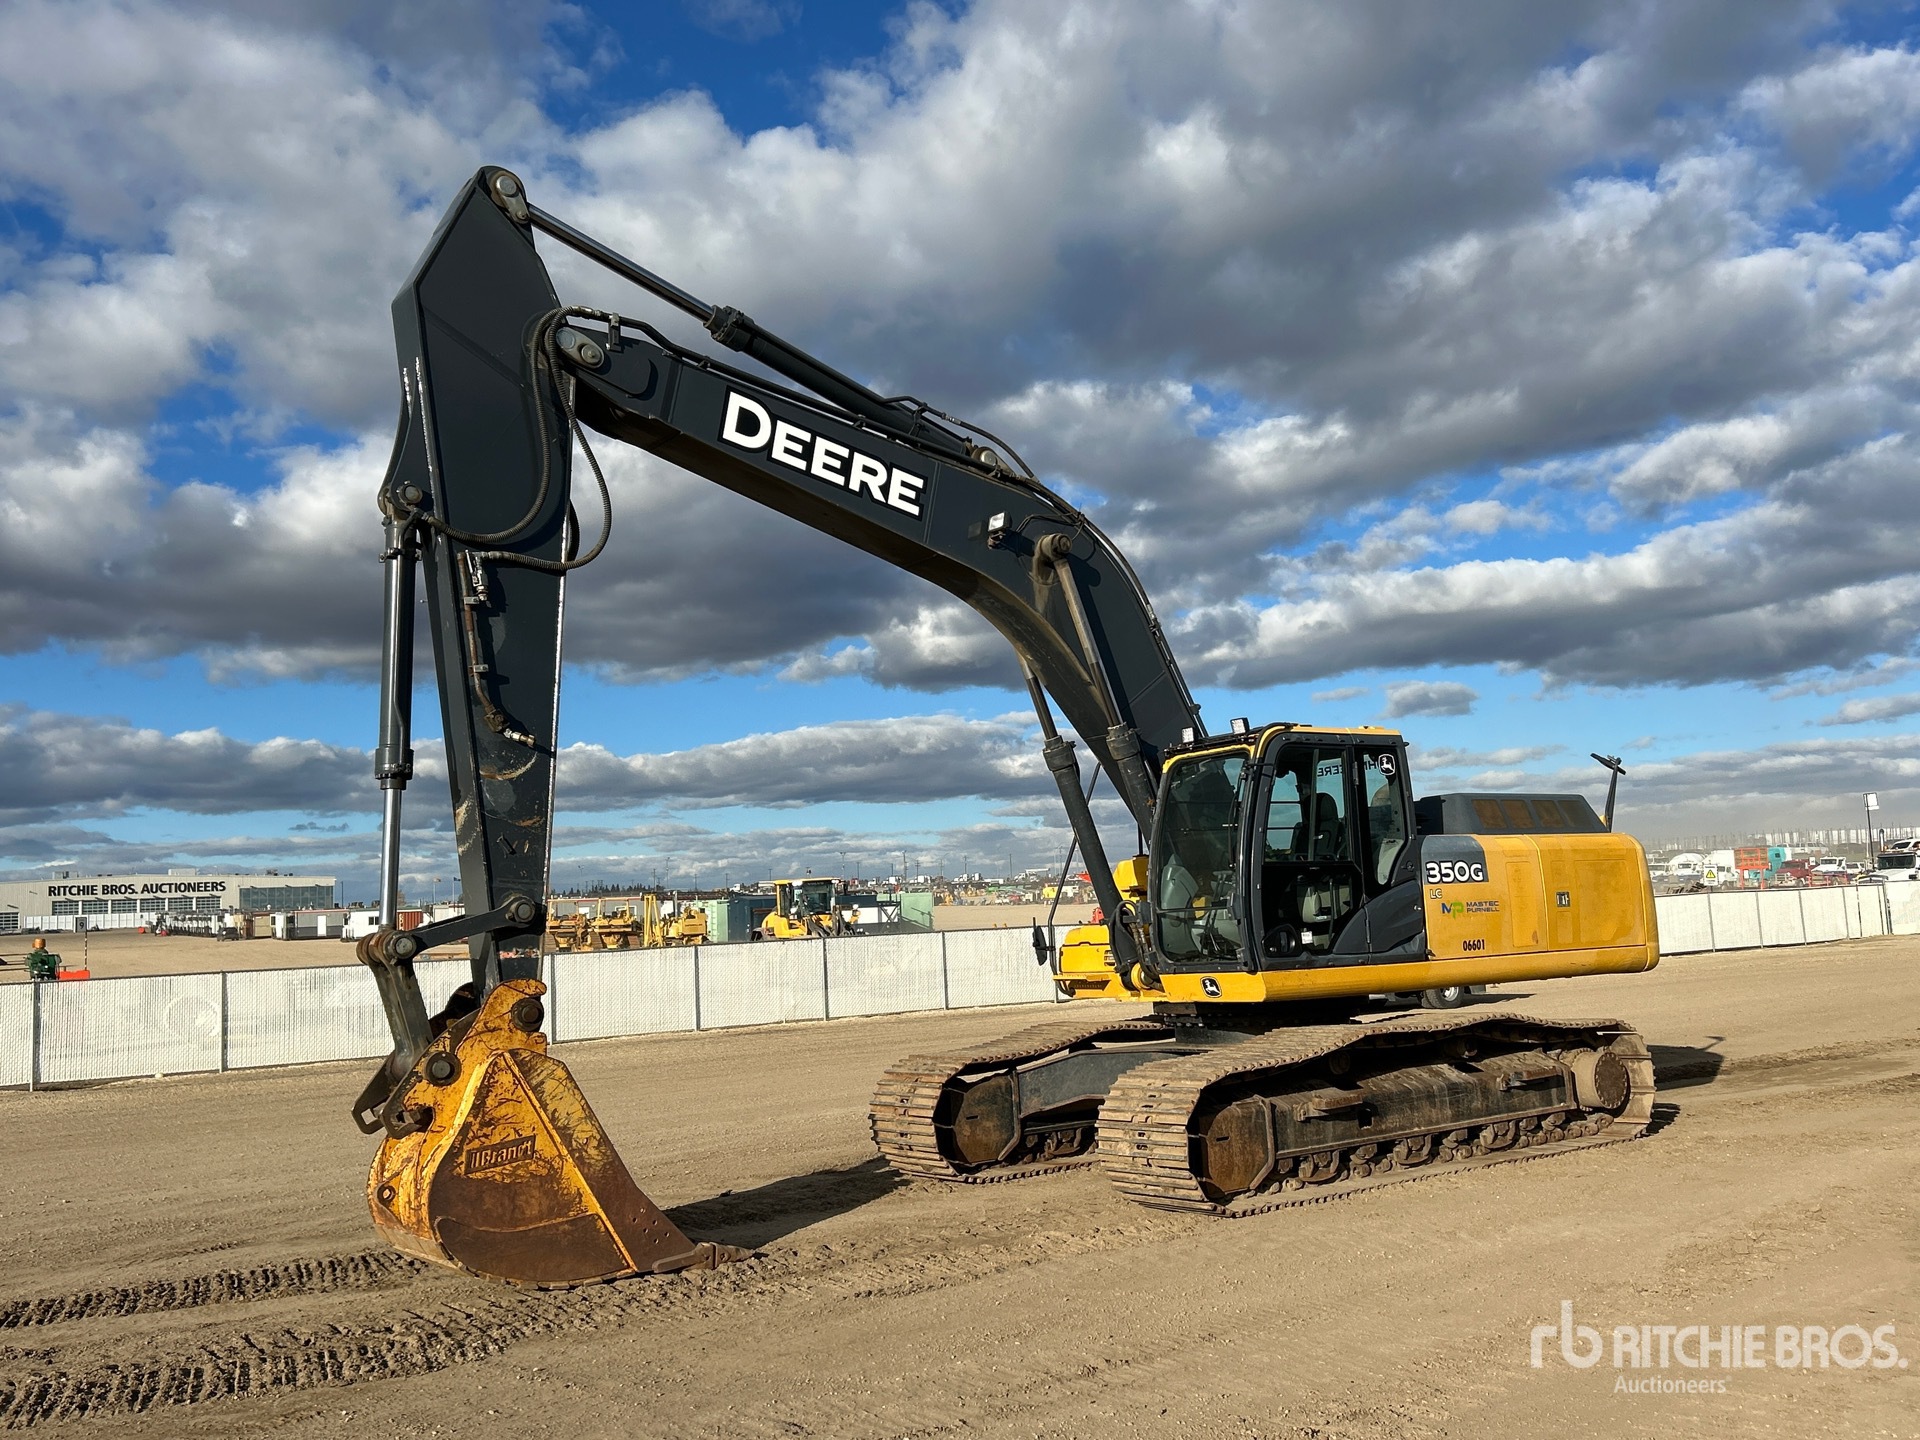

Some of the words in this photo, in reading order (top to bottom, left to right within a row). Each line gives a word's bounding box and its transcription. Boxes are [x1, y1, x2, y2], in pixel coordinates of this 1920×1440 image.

[722, 391, 924, 517] DEERE
[1426, 860, 1484, 883] 350G
[48, 884, 98, 897] RITCHIE
[101, 883, 139, 895] BROS.
[140, 881, 226, 894] AUCTIONEERS
[1430, 888, 1443, 899] LC
[1462, 939, 1485, 951] 06601
